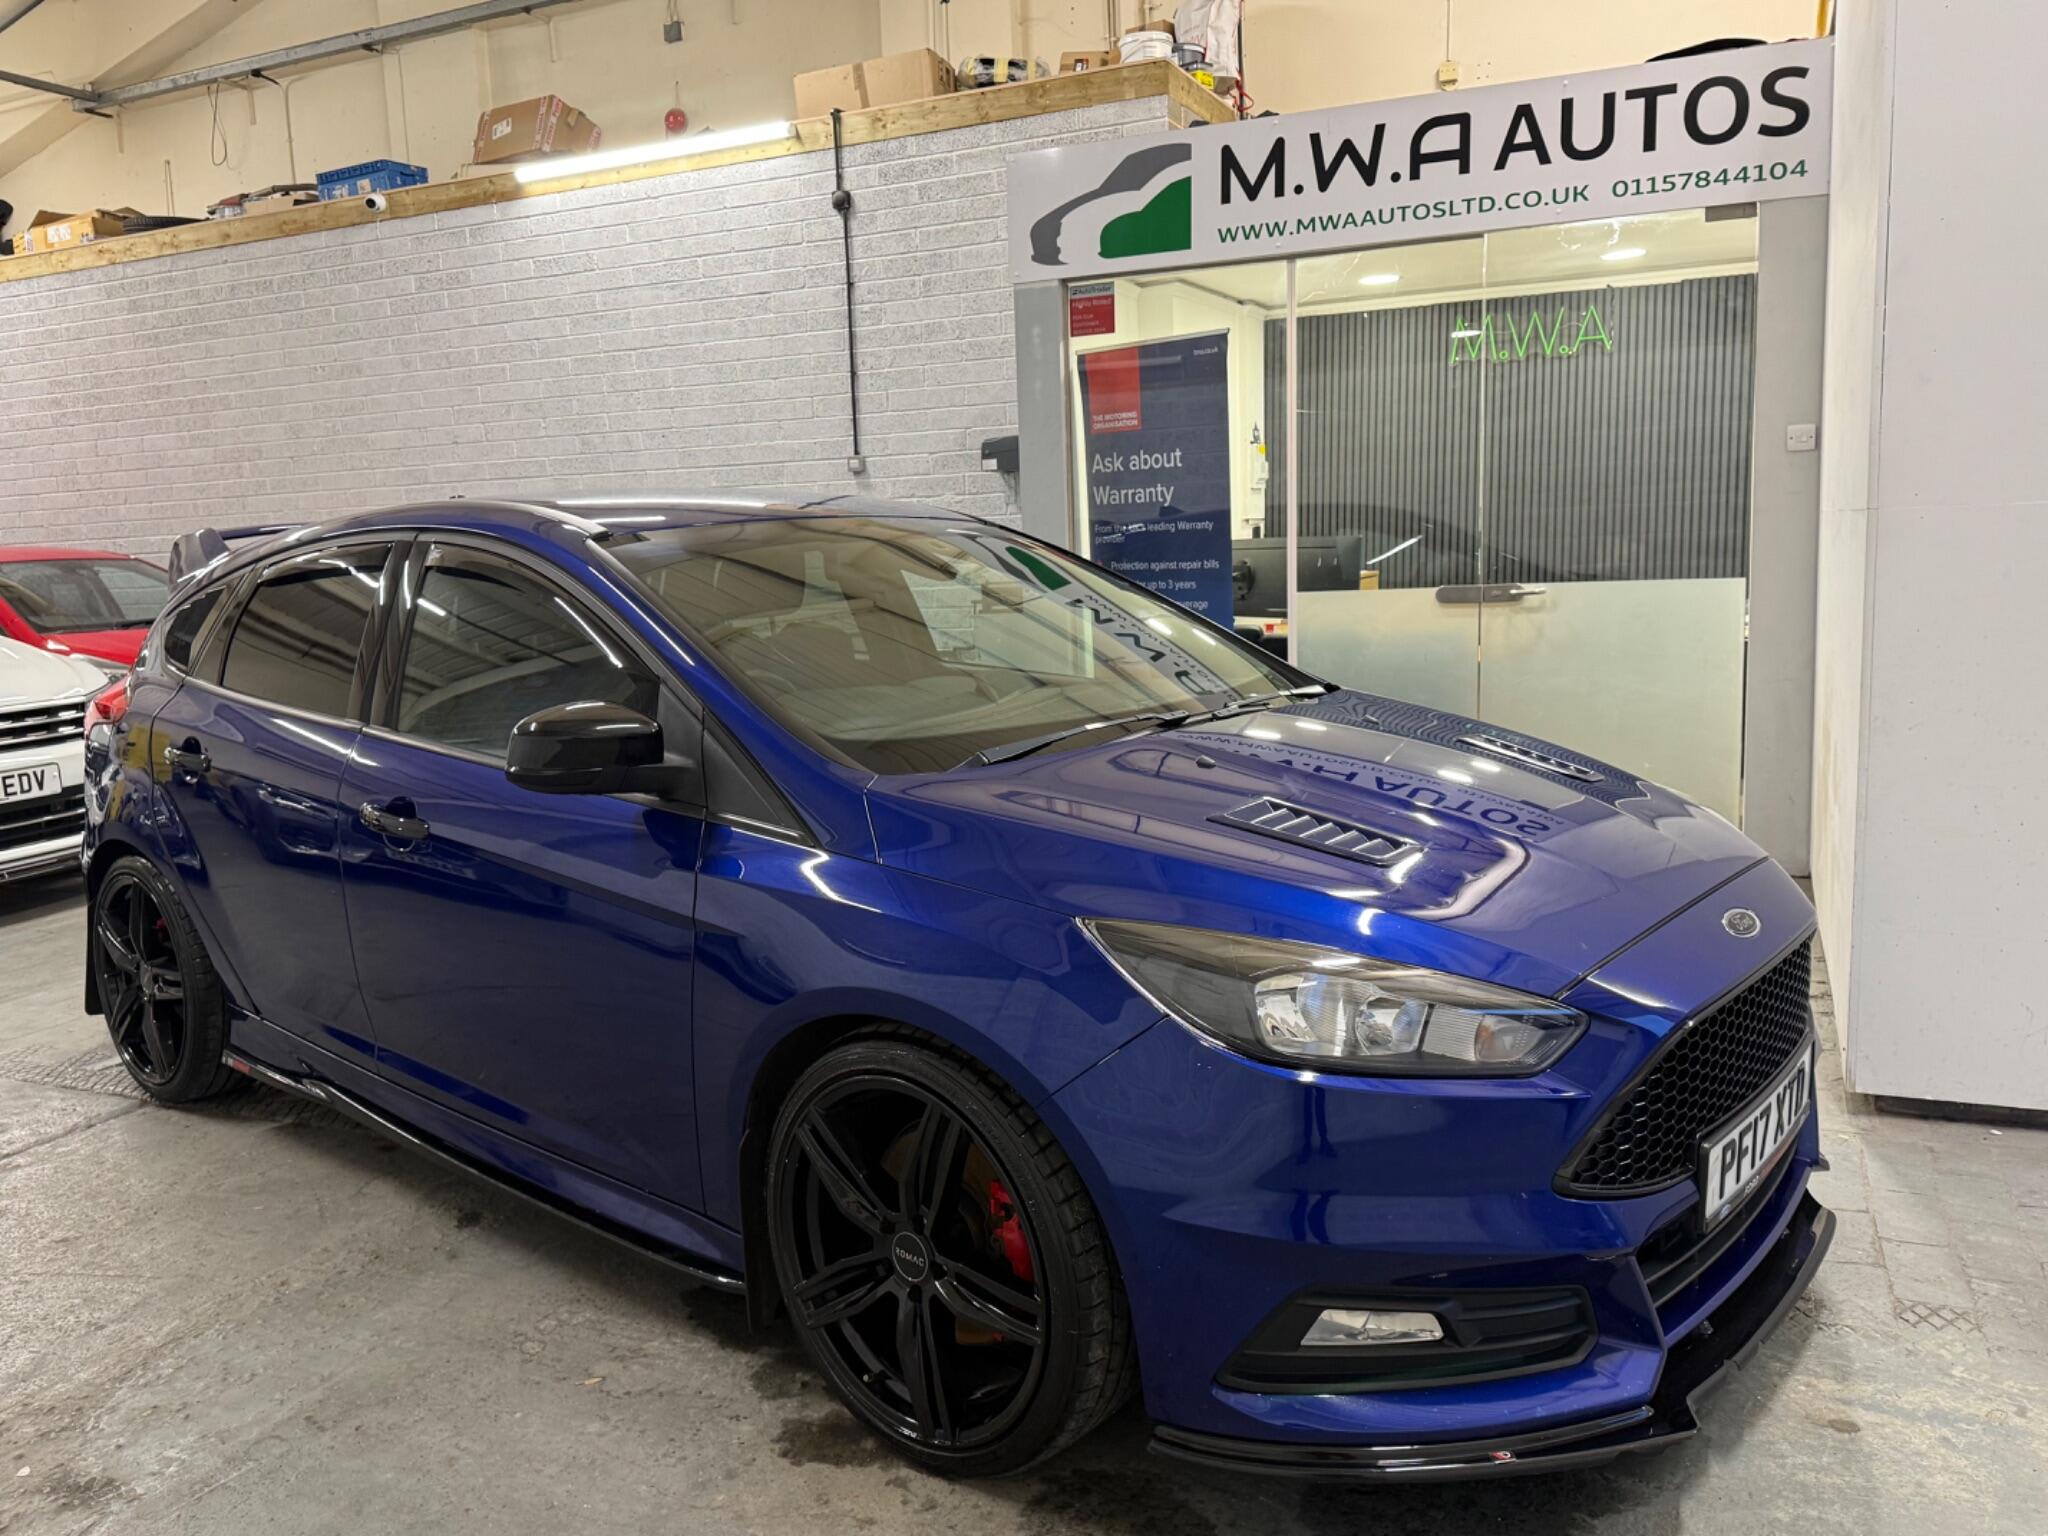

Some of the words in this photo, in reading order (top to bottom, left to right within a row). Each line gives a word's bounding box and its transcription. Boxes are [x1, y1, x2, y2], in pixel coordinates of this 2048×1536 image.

[1220, 112, 1472, 205] M.W.A
[1493, 66, 1811, 171] AUTOS
[1217, 184, 1590, 243] WWW.MWAAUTOSLTD.CO.UK
[1611, 159, 1809, 198] 01157844104
[1450, 305, 1612, 364] M.W.A
[1092, 452, 1124, 473] Ask
[1129, 448, 1182, 471] about
[1093, 483, 1174, 507] Warranty
[1094, 524, 1112, 534] From
[1147, 522, 1175, 533] leading
[1177, 520, 1214, 531] Warranty
[1111, 560, 1149, 571] Protection
[1150, 560, 1177, 572] against
[1179, 560, 1202, 571] repair
[1204, 559, 1220, 569] bills
[1159, 580, 1167, 589] to
[1168, 579, 1174, 589] 3
[1175, 581, 1197, 590] years
[1, 769, 45, 797] EDV
[1719, 1101, 1772, 1201] PF17
[1773, 1060, 1806, 1146] XTD
